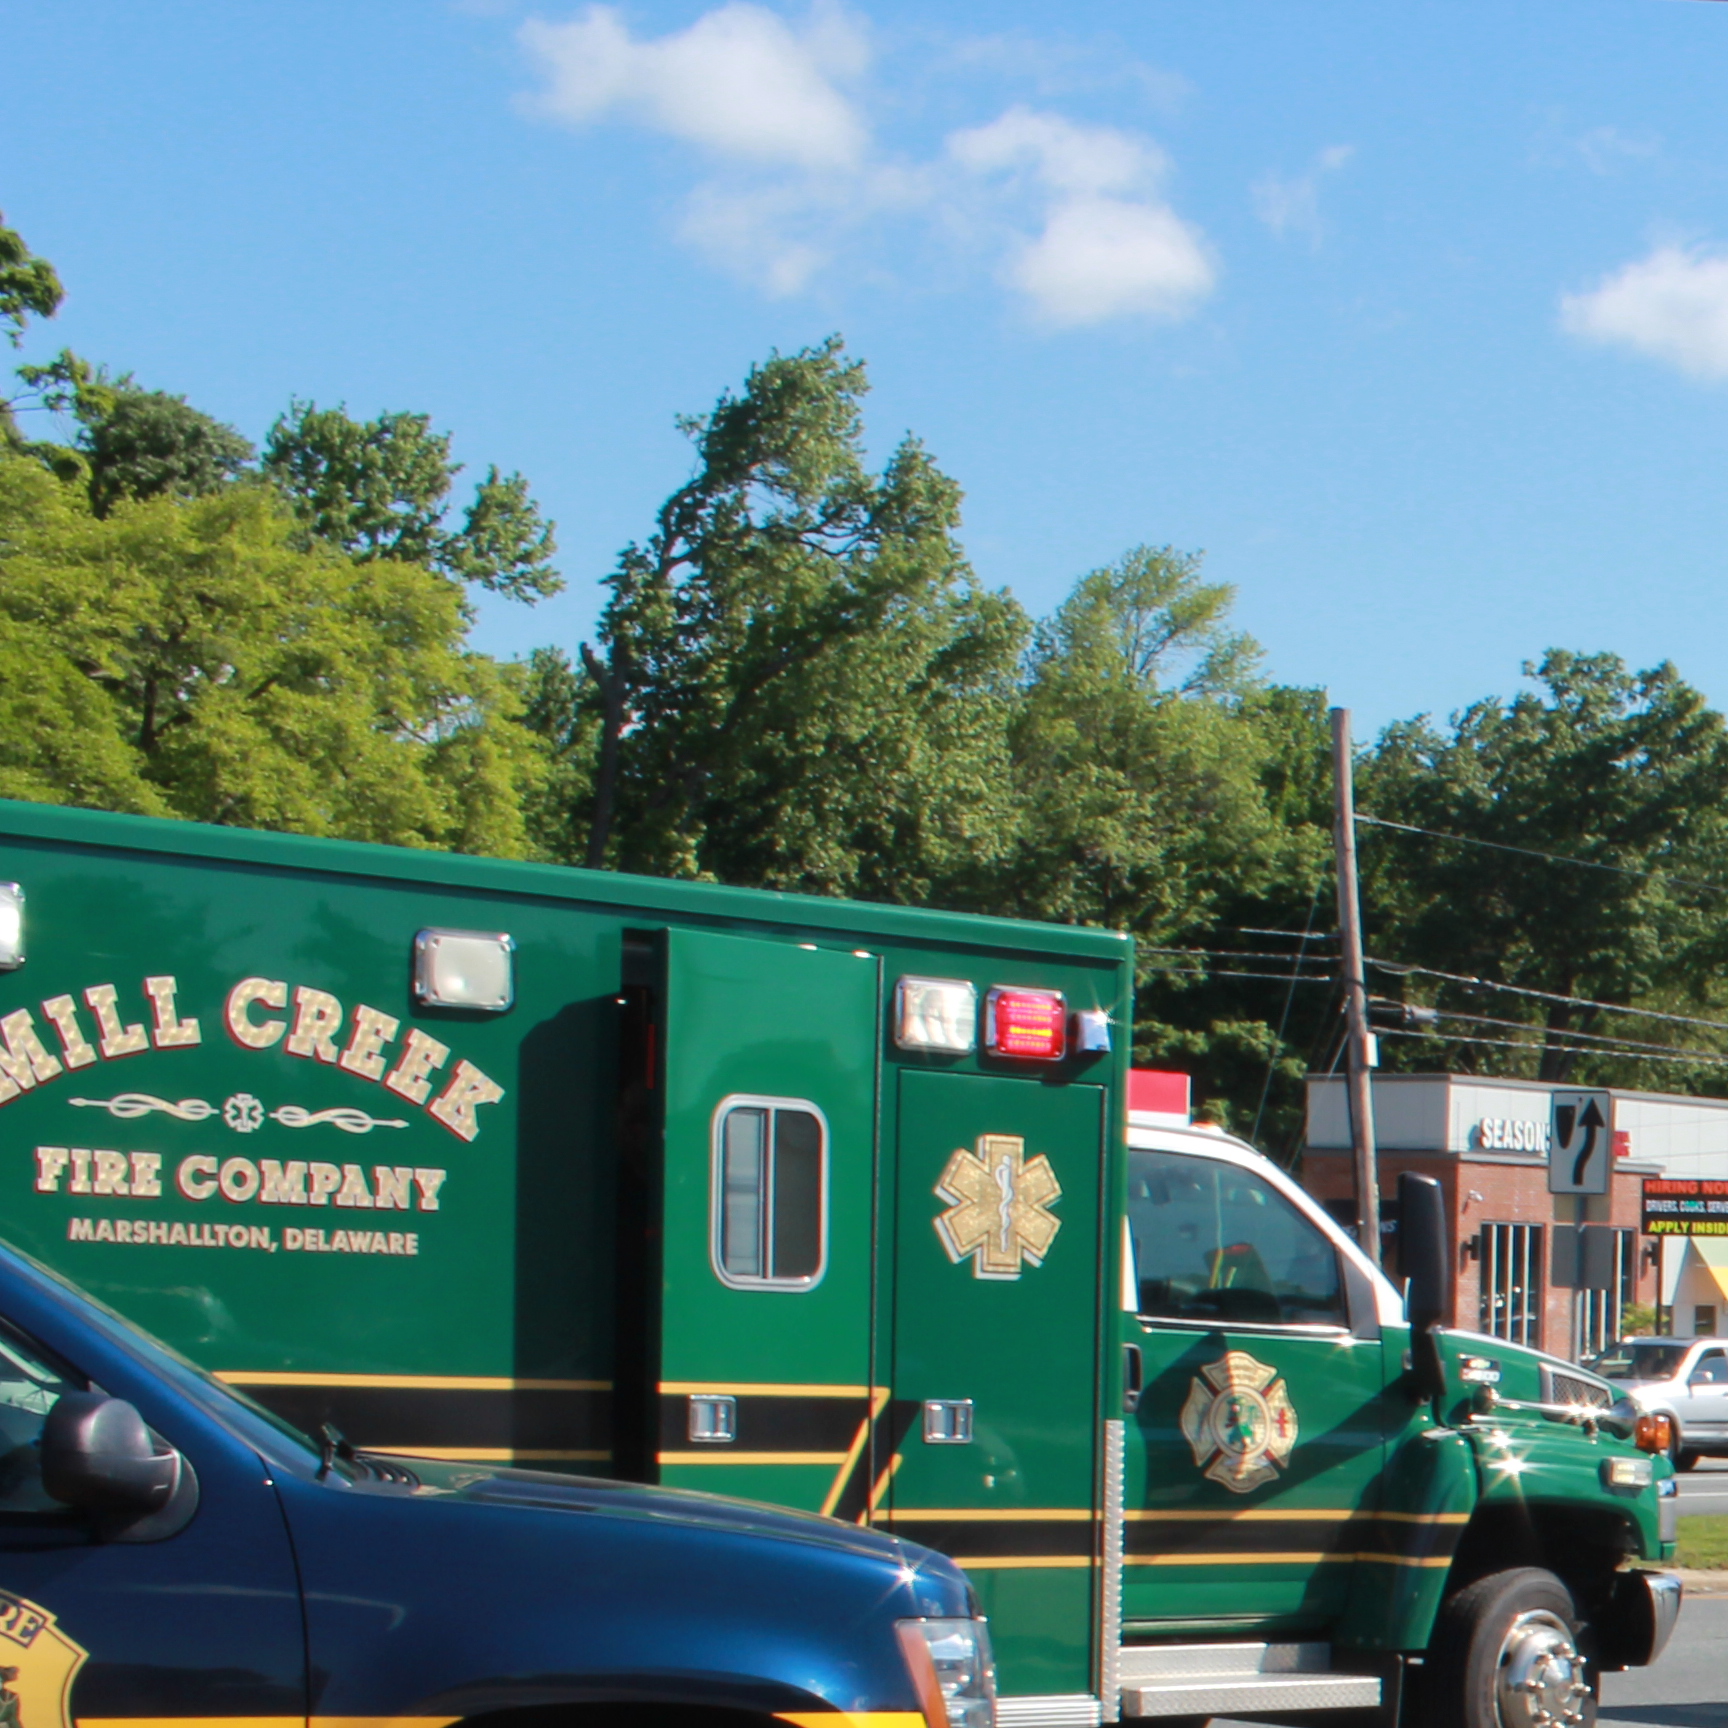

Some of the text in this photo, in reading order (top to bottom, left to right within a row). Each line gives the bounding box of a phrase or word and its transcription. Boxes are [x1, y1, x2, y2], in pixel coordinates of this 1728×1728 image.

[0, 975, 505, 1143] MILL CREEK
[35, 1145, 448, 1212] FIRE COMPANY
[1644, 1179, 1699, 1195] HIRING
[67, 1216, 420, 1256] MARSHALLTON, DELAWARE
[1648, 1220, 1690, 1234] APPLY
